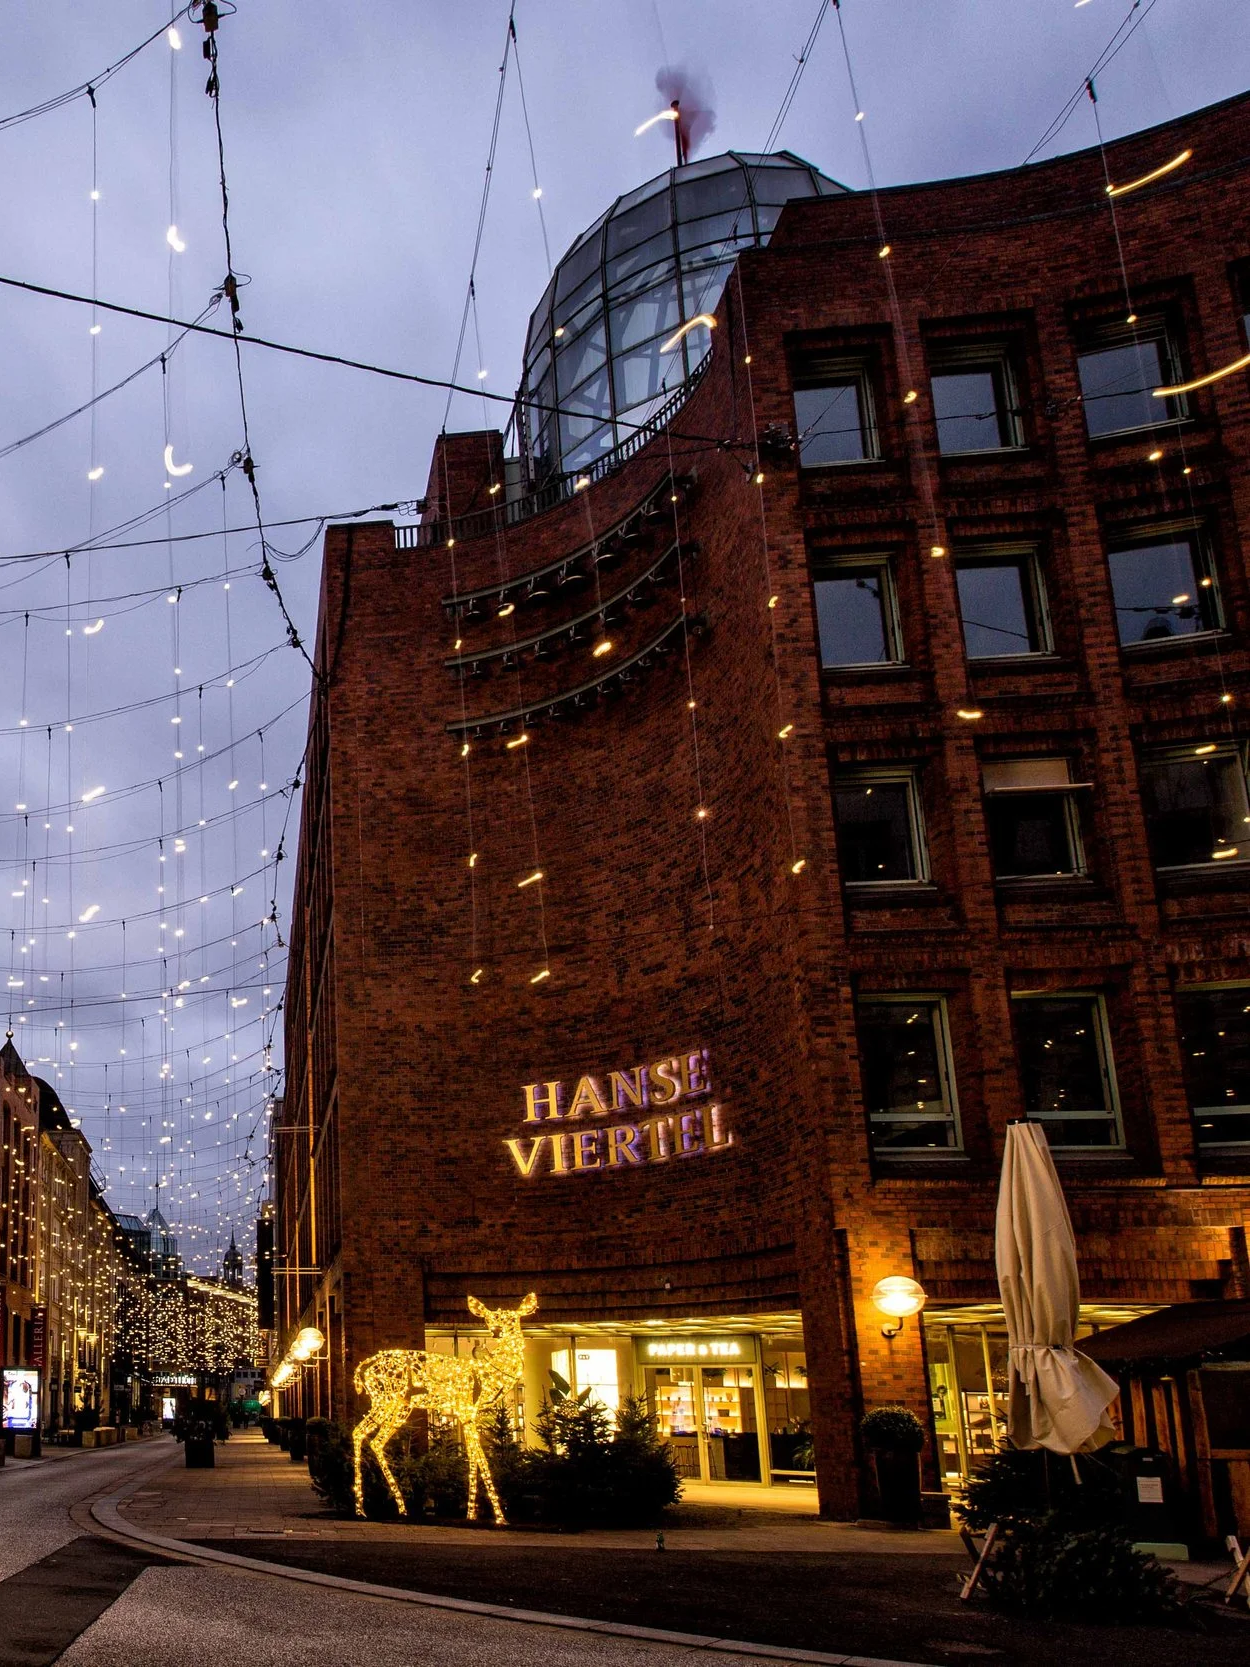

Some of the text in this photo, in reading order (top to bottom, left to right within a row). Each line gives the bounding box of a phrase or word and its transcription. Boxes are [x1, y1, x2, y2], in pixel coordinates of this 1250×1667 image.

[521, 1050, 706, 1122] HANSE
[502, 1105, 730, 1176] VIERTEL
[648, 1343, 696, 1356] PAPER
[709, 1342, 741, 1356] TEA
